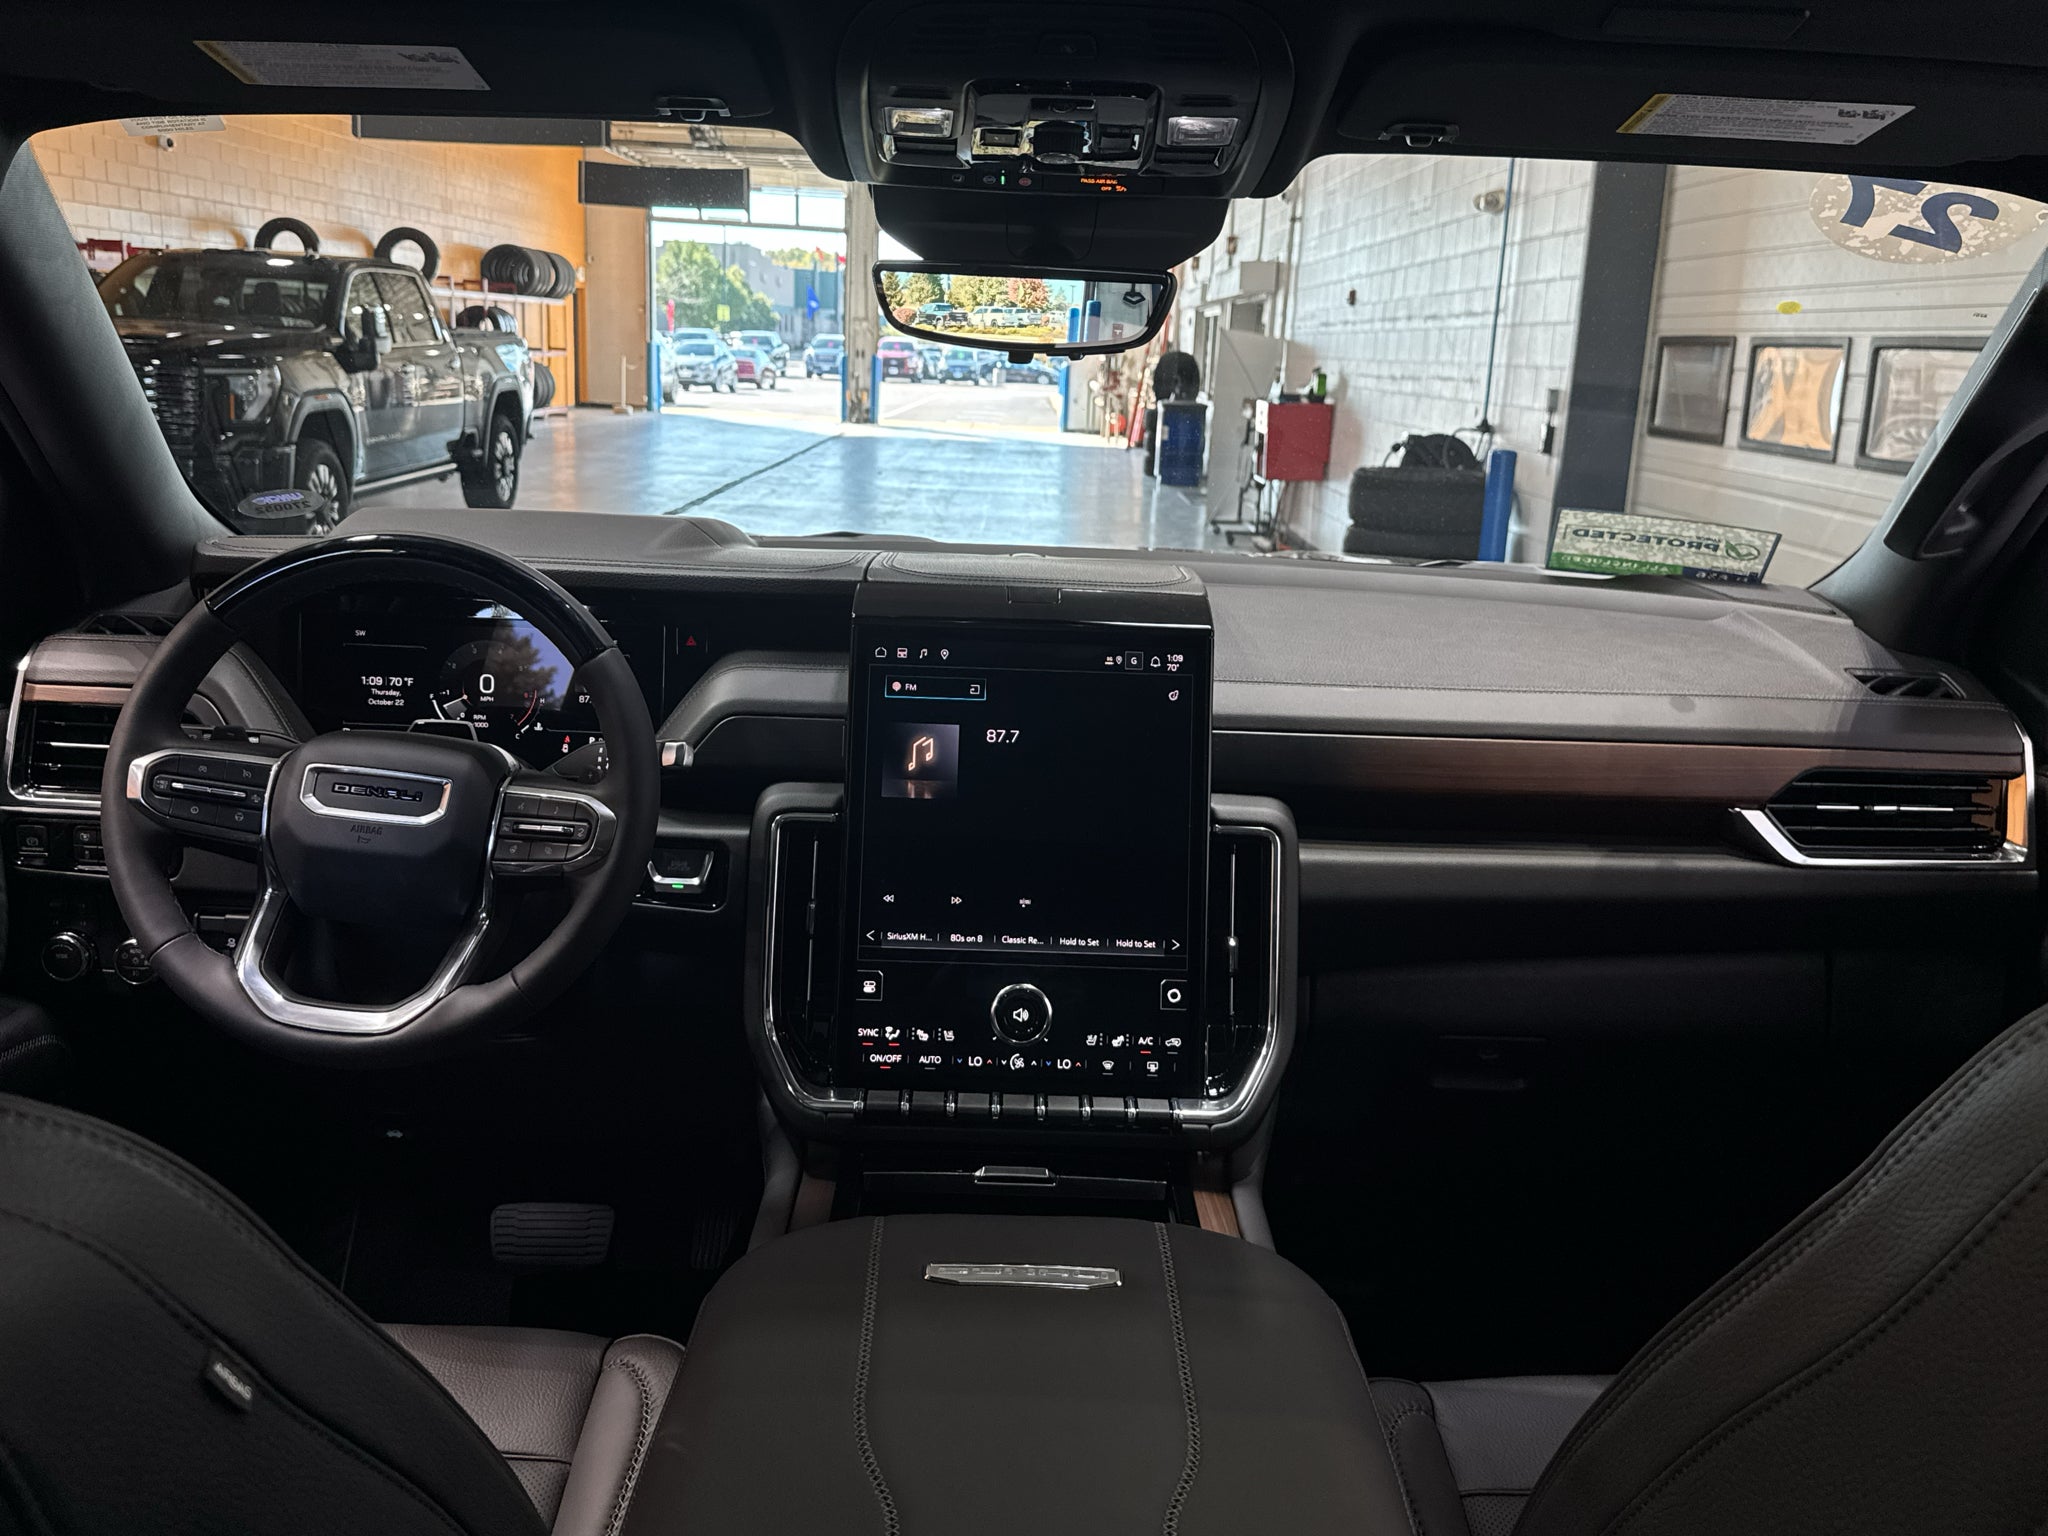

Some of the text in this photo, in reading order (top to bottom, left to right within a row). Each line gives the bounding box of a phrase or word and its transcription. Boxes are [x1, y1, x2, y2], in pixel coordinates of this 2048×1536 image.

[1166, 654, 1184, 662] 1:09
[361, 676, 383, 686] 1:09
[389, 676, 403, 686] 70
[479, 674, 495, 694] 0
[905, 683, 917, 692] FM
[371, 688, 402, 697] Thursday,
[368, 698, 395, 706] October
[986, 729, 1020, 743] 87.7
[350, 824, 383, 836] AIRBAG
[887, 931, 918, 941] SiriusXM
[966, 935, 976, 943] on
[1001, 935, 1027, 944] Classic
[1059, 936, 1100, 947] Hold to Set
[1116, 938, 1156, 949] Hold to Set
[857, 1028, 879, 1037] SYNC
[1138, 1036, 1154, 1045] A/C
[869, 1053, 1071, 1069] ON/OFF AUTO LO LO
